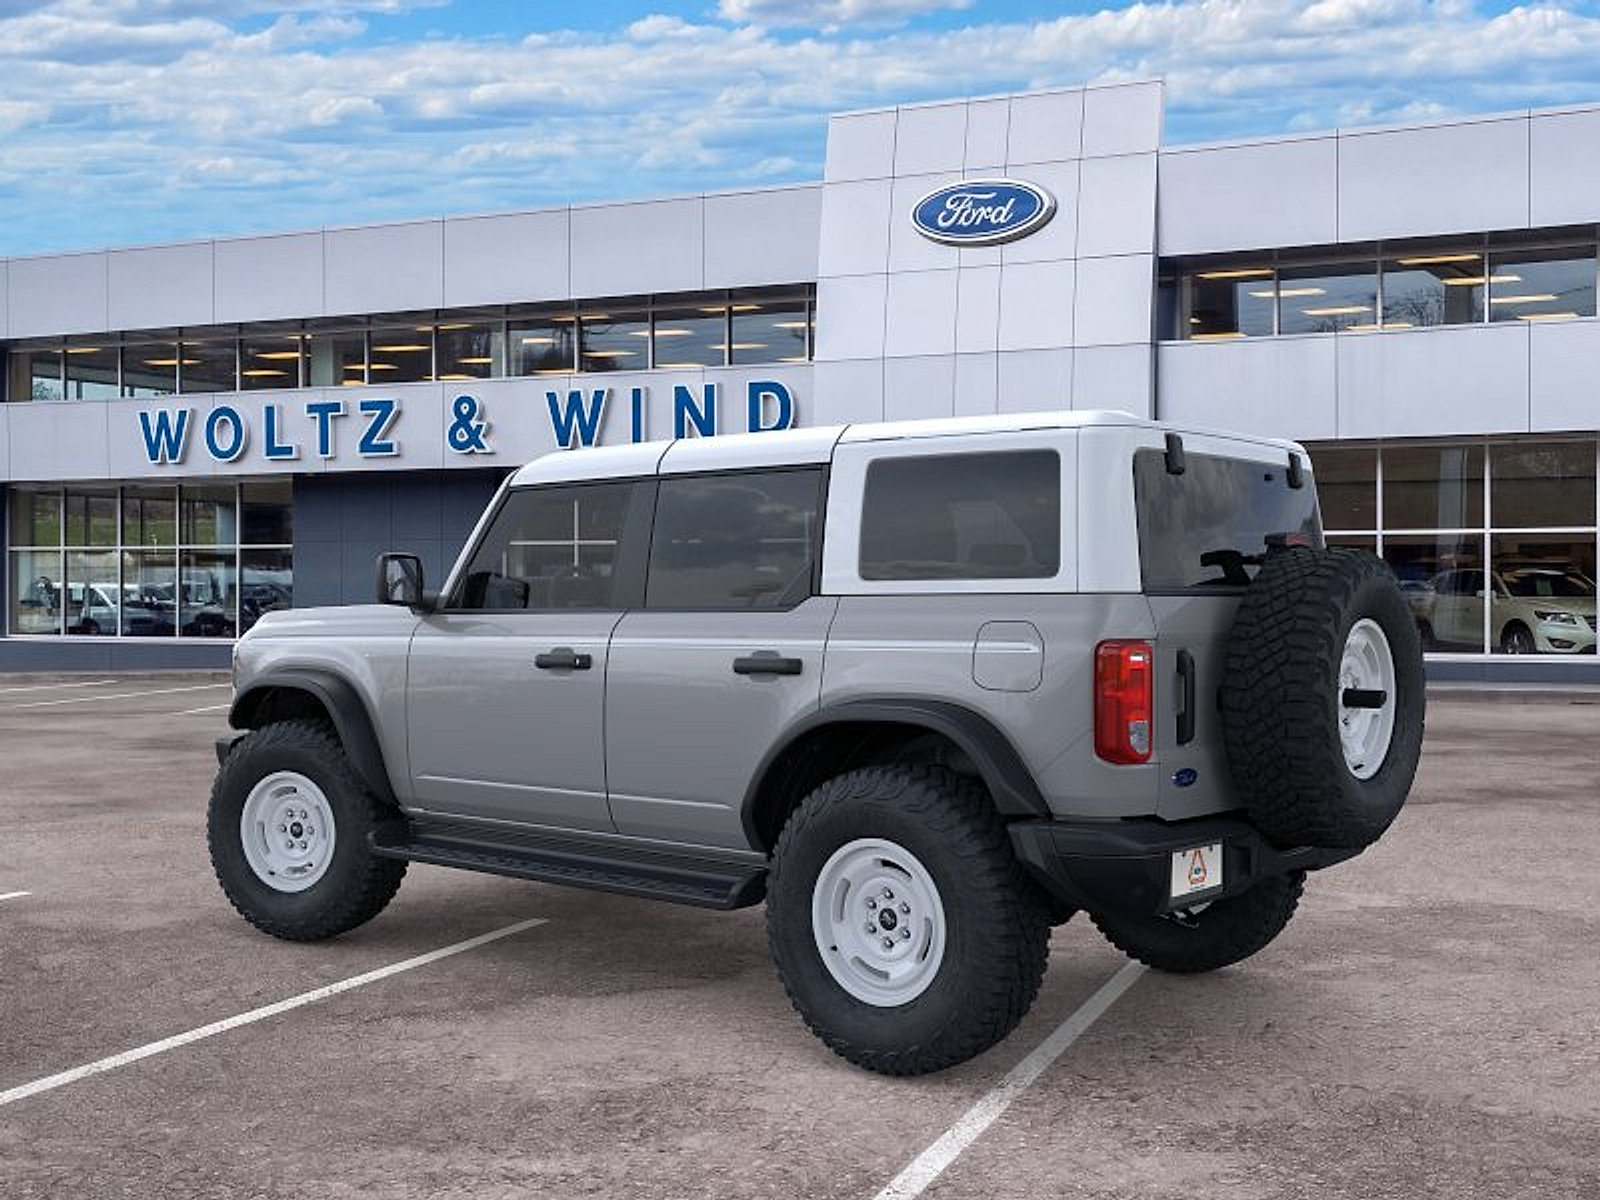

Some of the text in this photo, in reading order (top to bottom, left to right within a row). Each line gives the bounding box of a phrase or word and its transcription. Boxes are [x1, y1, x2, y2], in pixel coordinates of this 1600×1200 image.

[937, 192, 1015, 228] Ford
[138, 379, 796, 464] WOLTZ & WIND
